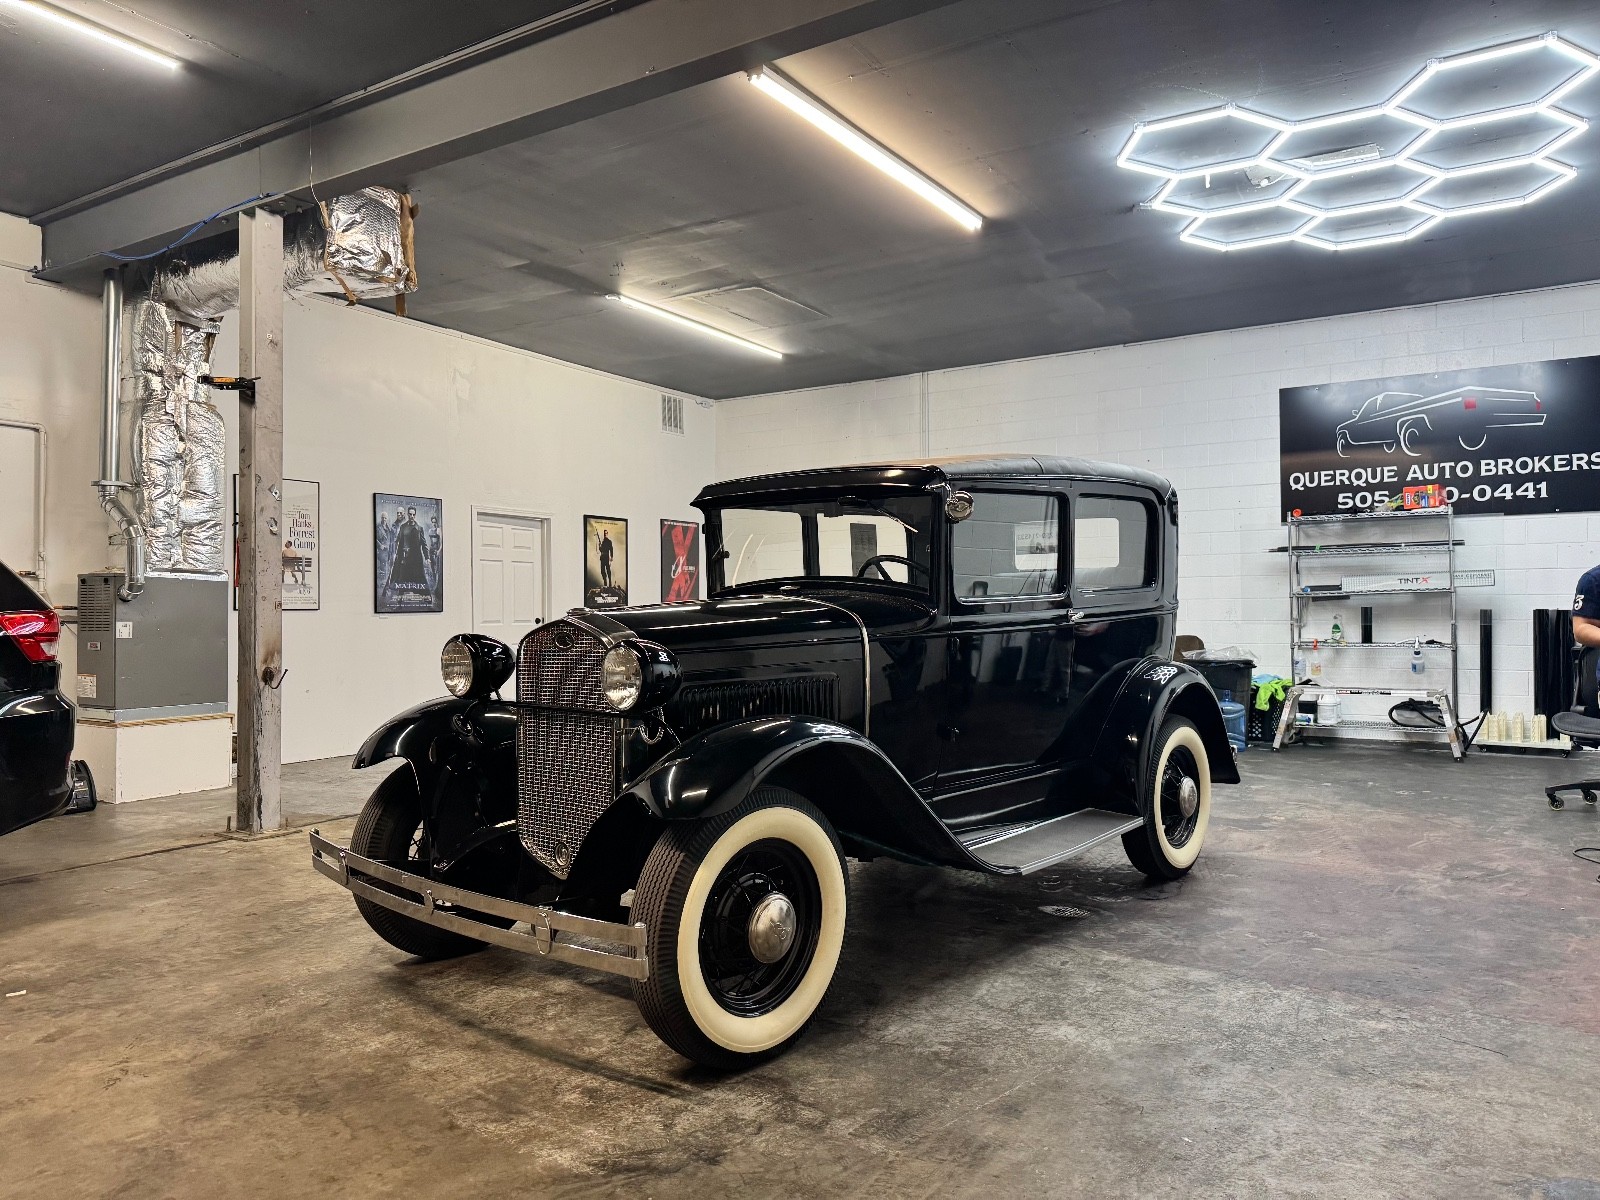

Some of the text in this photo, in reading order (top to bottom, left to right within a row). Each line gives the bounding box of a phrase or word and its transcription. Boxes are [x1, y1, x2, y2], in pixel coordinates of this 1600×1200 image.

[1289, 452, 1600, 490] QUERQUE AUTO BROKERS
[1445, 481, 1549, 503] 0-0441
[297, 511, 311, 519] Tom
[289, 527, 315, 538] Forrest
[293, 538, 316, 551] Gump
